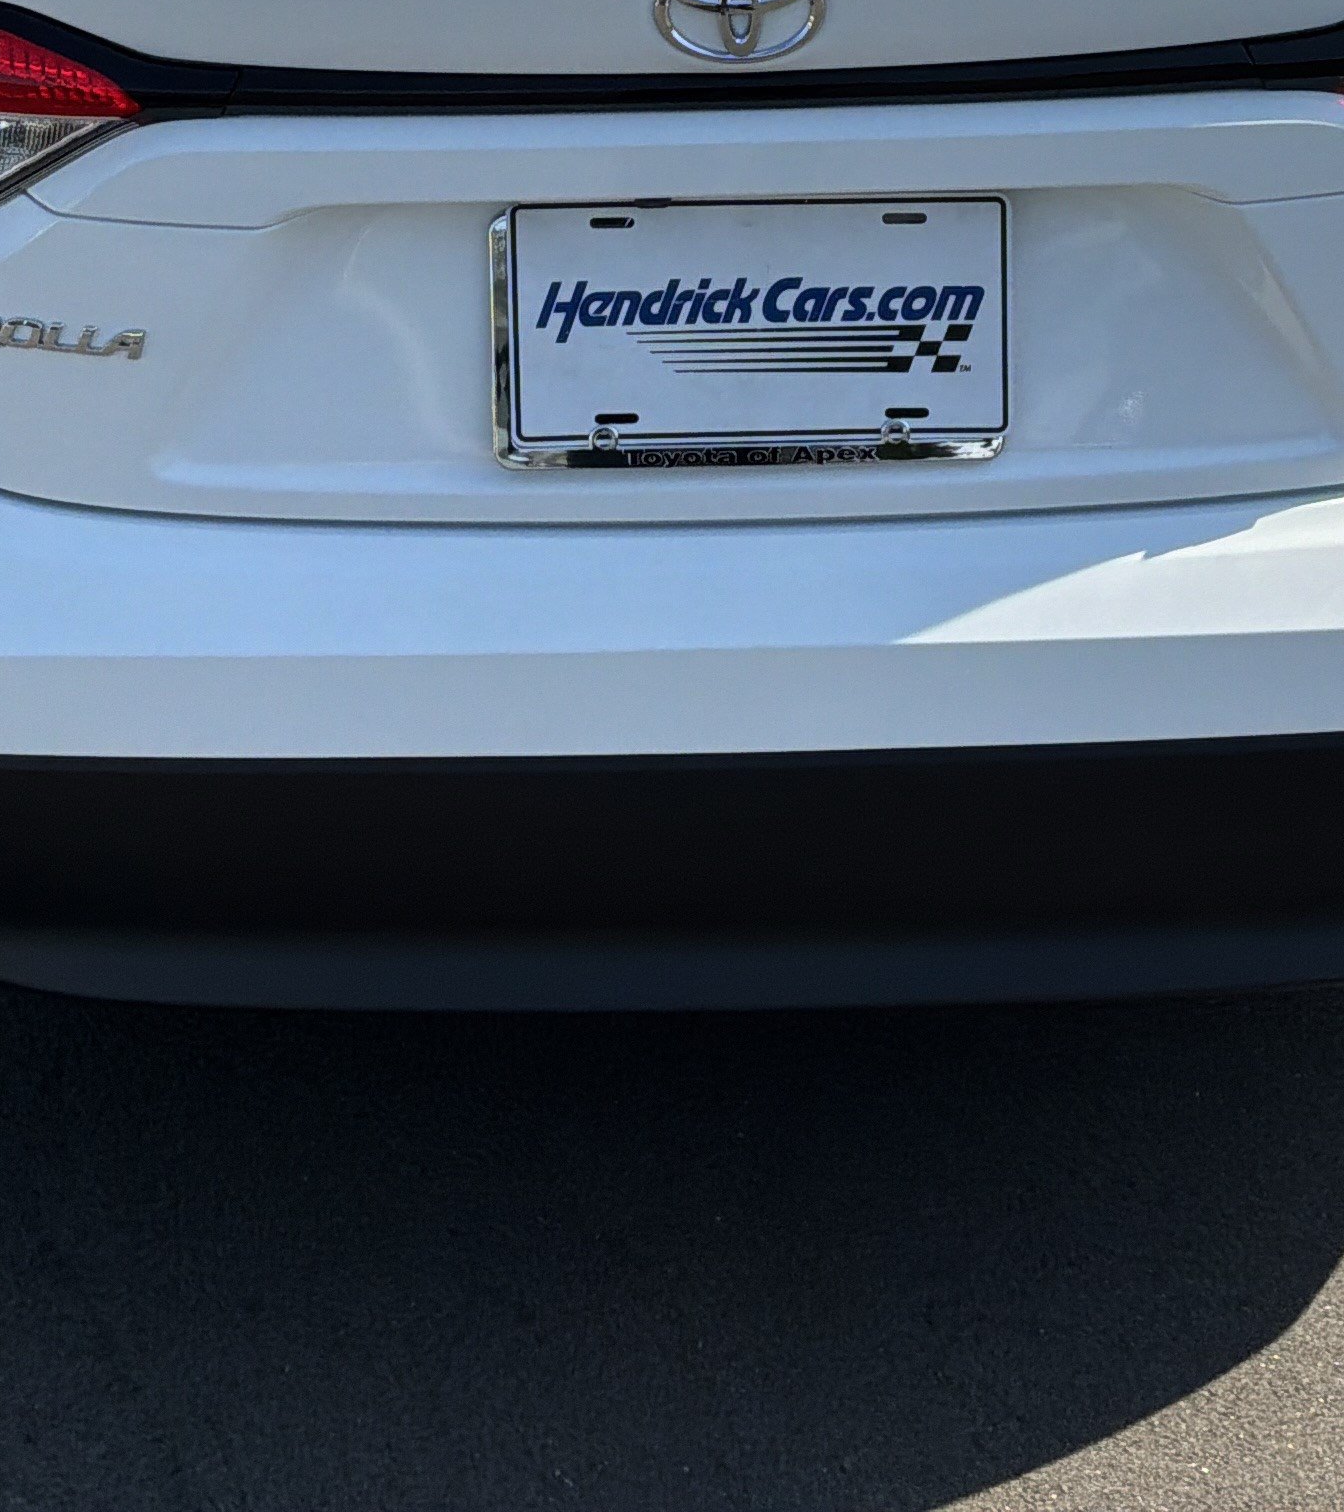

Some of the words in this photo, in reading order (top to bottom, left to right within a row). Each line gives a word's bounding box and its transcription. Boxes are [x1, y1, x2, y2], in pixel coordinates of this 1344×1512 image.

[623, 447, 738, 468] Toyota
[746, 446, 783, 465] of
[790, 445, 881, 465] Apex
